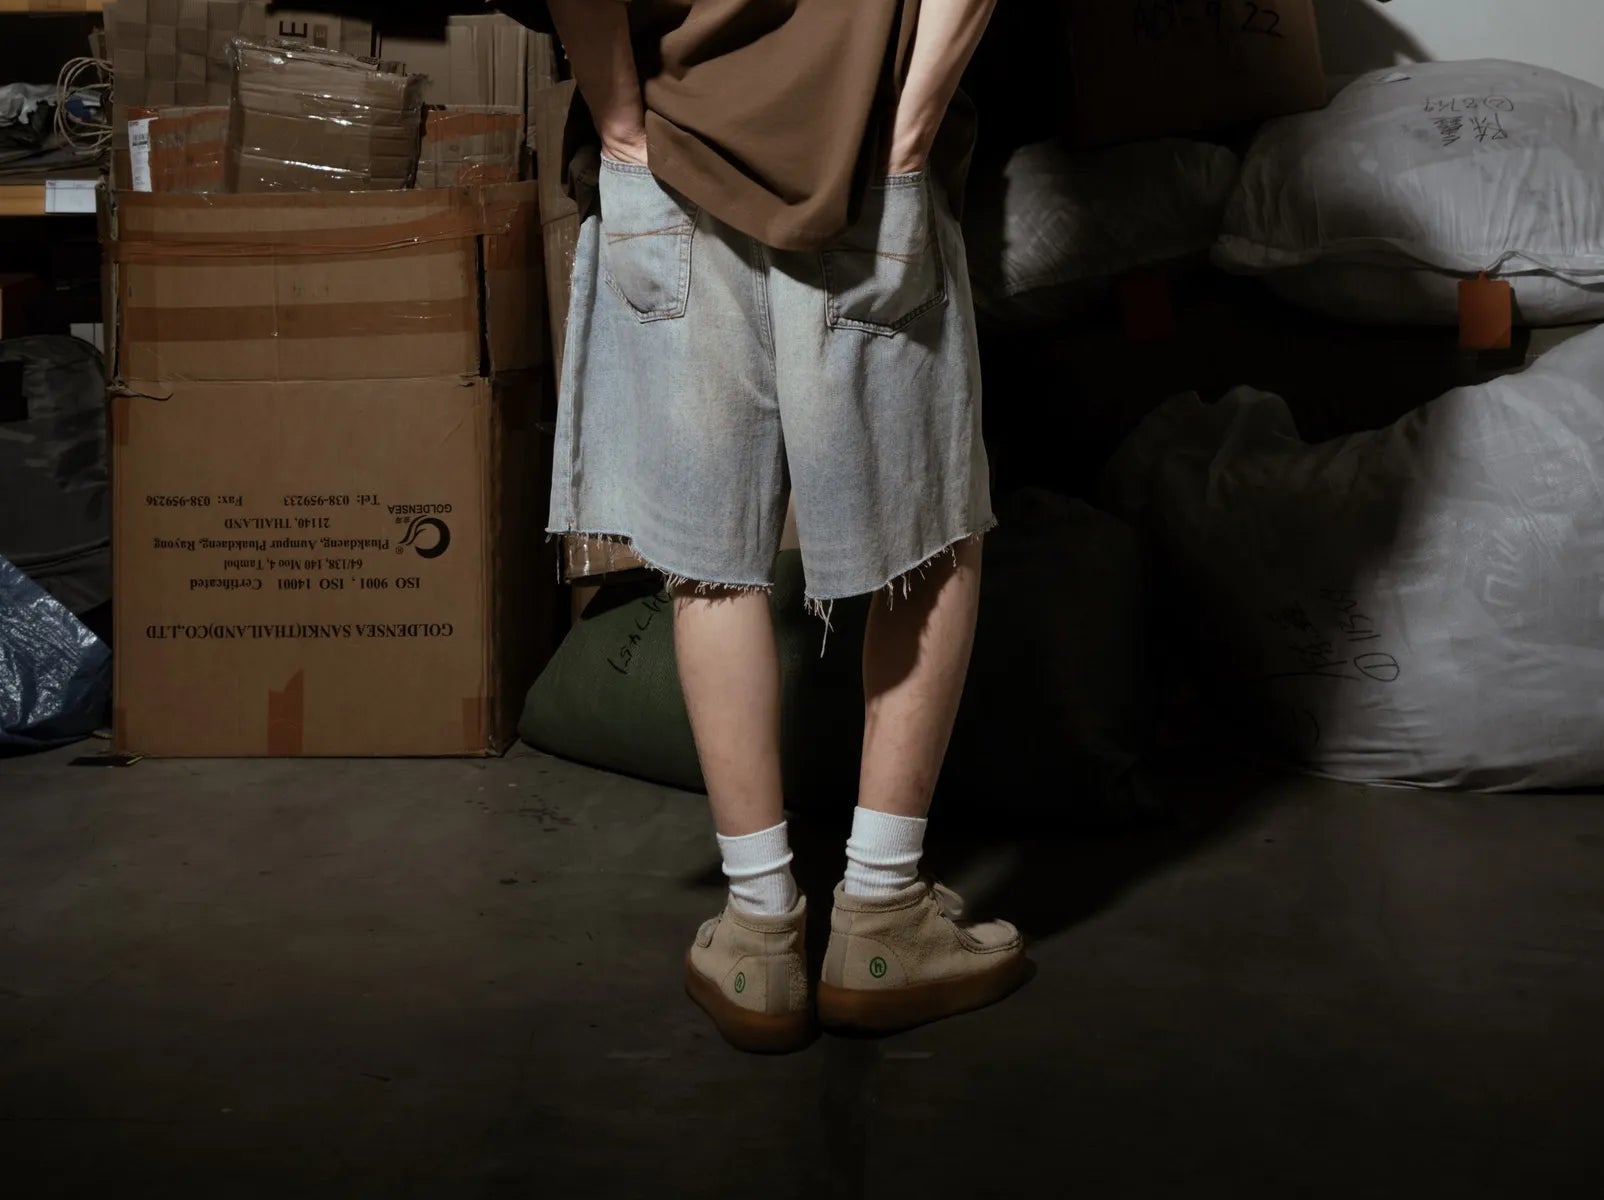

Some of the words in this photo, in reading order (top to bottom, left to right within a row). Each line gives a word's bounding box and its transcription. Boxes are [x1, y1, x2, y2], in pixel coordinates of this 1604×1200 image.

[146, 495, 211, 507] 038-959236
[217, 495, 242, 506] Fax:
[283, 495, 350, 506] 038-959233
[356, 495, 380, 505] Tel:
[387, 504, 452, 514] GOLDENSEA
[225, 518, 292, 528] THAILAND
[294, 517, 329, 528] 21140,
[153, 538, 195, 551] Rayong
[199, 539, 266, 551] Pluakdaeng,
[270, 538, 316, 550] Aumpur
[320, 538, 389, 550] Pluakdaeng,
[224, 559, 262, 570] Tambol
[278, 559, 301, 569] Moo
[305, 560, 322, 569] 140
[326, 559, 362, 569] 64/138,
[190, 578, 262, 590] Certificated
[278, 578, 311, 590] 14001
[320, 578, 344, 589] ISO
[396, 577, 420, 588] ISO
[146, 624, 351, 639] SANKI(THAILAND)CO.,LTD
[356, 623, 453, 638] GOLDENSEA
